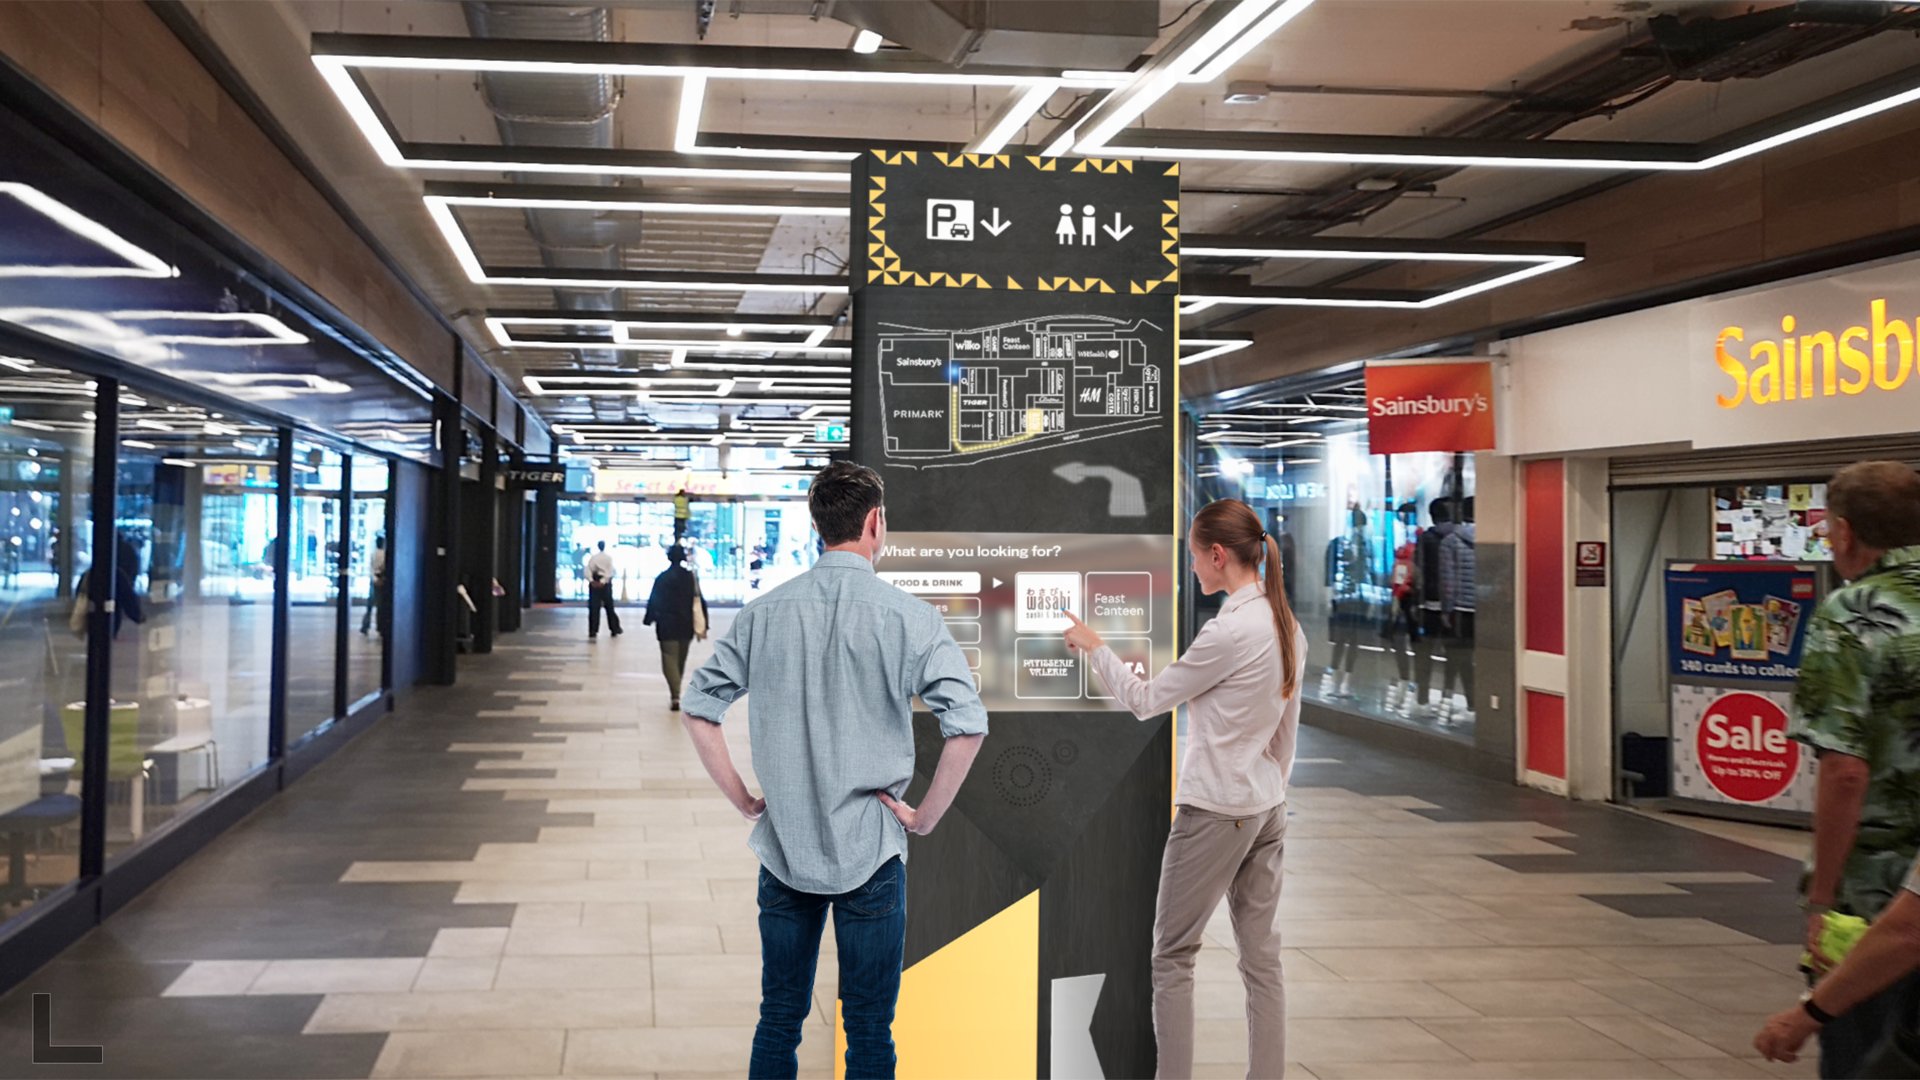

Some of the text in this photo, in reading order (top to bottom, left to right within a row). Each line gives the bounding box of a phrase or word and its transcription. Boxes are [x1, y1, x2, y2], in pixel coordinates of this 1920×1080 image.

[955, 340, 981, 350] wilko
[1715, 299, 1920, 409] Sainsb
[896, 357, 942, 368] Sainsbury's
[1080, 388, 1102, 403] H&M
[1372, 393, 1488, 416] Sainsbury's
[893, 409, 943, 419] PRIMARK
[509, 471, 565, 483] TIGER
[881, 545, 1062, 559] What are you looking for?
[893, 579, 963, 587] FOOD & DRINK
[1026, 590, 1071, 610] wasabi
[1094, 593, 1126, 604] Feast
[1094, 605, 1144, 616] Canteen
[1023, 659, 1075, 668] PATISSERIE
[1704, 662, 1739, 674] cards
[1741, 664, 1757, 675] to
[1759, 665, 1802, 677] collec
[1028, 668, 1068, 677] VALERIE
[1706, 714, 1787, 754] Sale
[1711, 765, 1726, 777] Up
[1726, 768, 1739, 776] to
